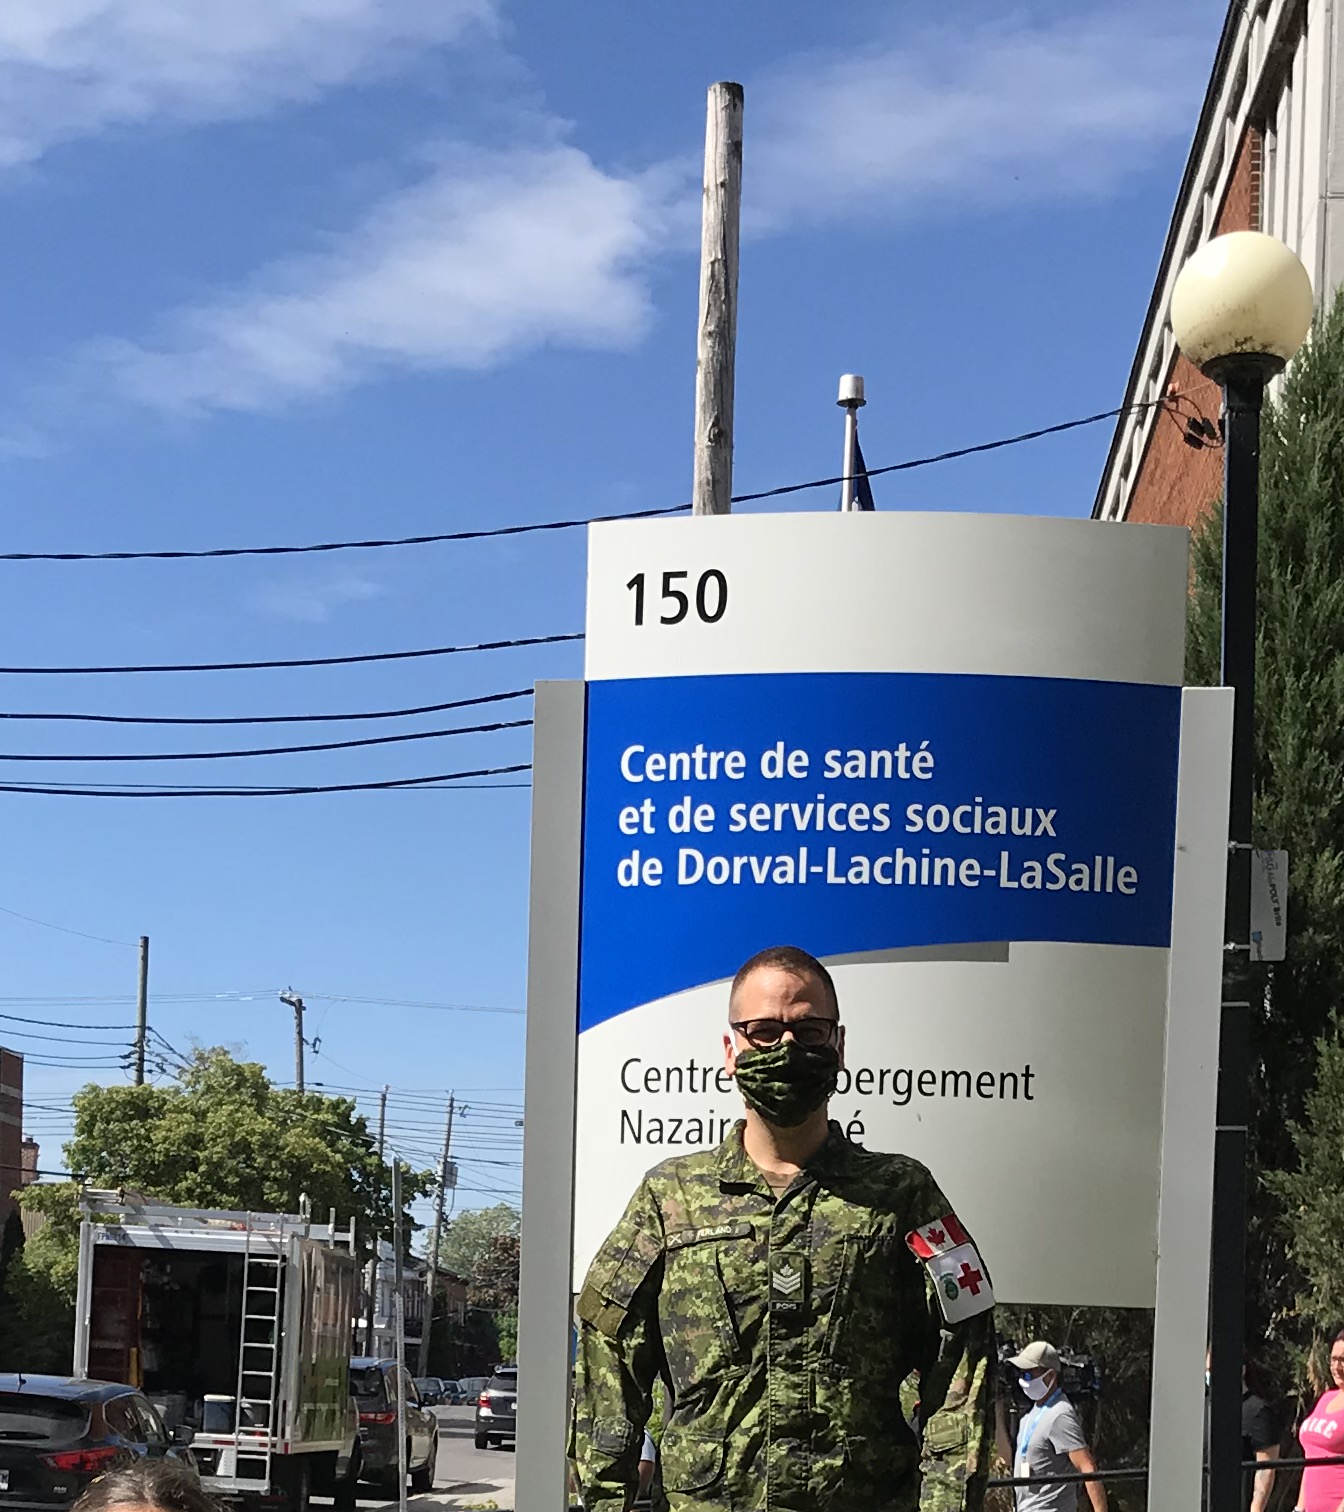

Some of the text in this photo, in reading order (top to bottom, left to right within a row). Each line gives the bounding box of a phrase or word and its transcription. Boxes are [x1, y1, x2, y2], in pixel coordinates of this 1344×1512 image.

[626, 568, 728, 626] 150
[619, 740, 934, 783] Centre de santé
[618, 793, 1057, 837] et de services sociaux
[617, 847, 1139, 894] de Dorval-Lachine-LaSalle
[620, 1058, 733, 1093] Centre
[619, 1110, 731, 1146] Nazair
